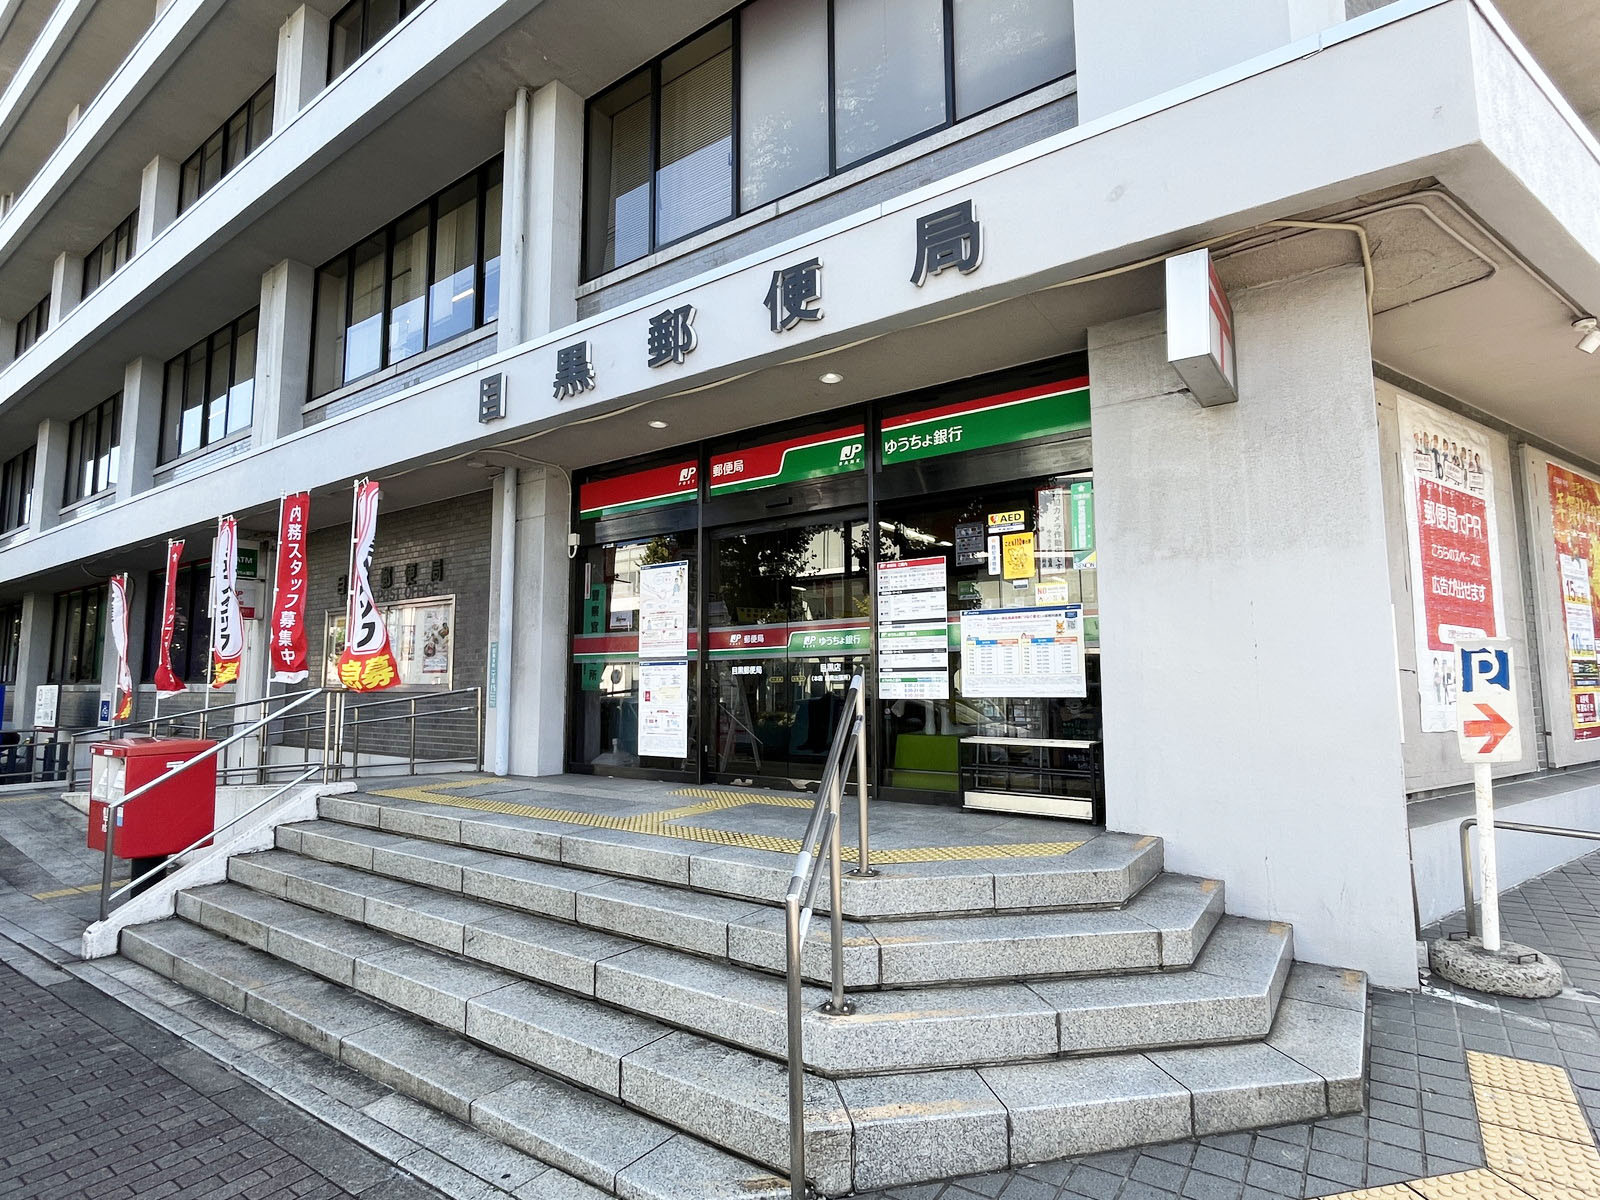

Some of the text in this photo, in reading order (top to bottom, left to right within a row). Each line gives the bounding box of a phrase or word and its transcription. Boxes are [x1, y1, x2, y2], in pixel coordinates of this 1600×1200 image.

[479, 199, 983, 423] 目黒郵便局
[885, 426, 963, 455] ゆうちょ銀行
[712, 459, 744, 477] 郵便局
[1000, 512, 1022, 523] AED
[1424, 500, 1482, 539] 郵便局でPR
[1431, 544, 1481, 567] こちらのスペースに
[278, 505, 303, 666] 内務スタッフ募集中
[337, 558, 444, 596] 目郵便局
[1432, 575, 1487, 602] 広告が出せます
[589, 589, 600, 681] 警察官所
[743, 633, 765, 644] 郵便局
[818, 634, 861, 646] ゆうちょ銀行
[1471, 652, 1500, 693] P
